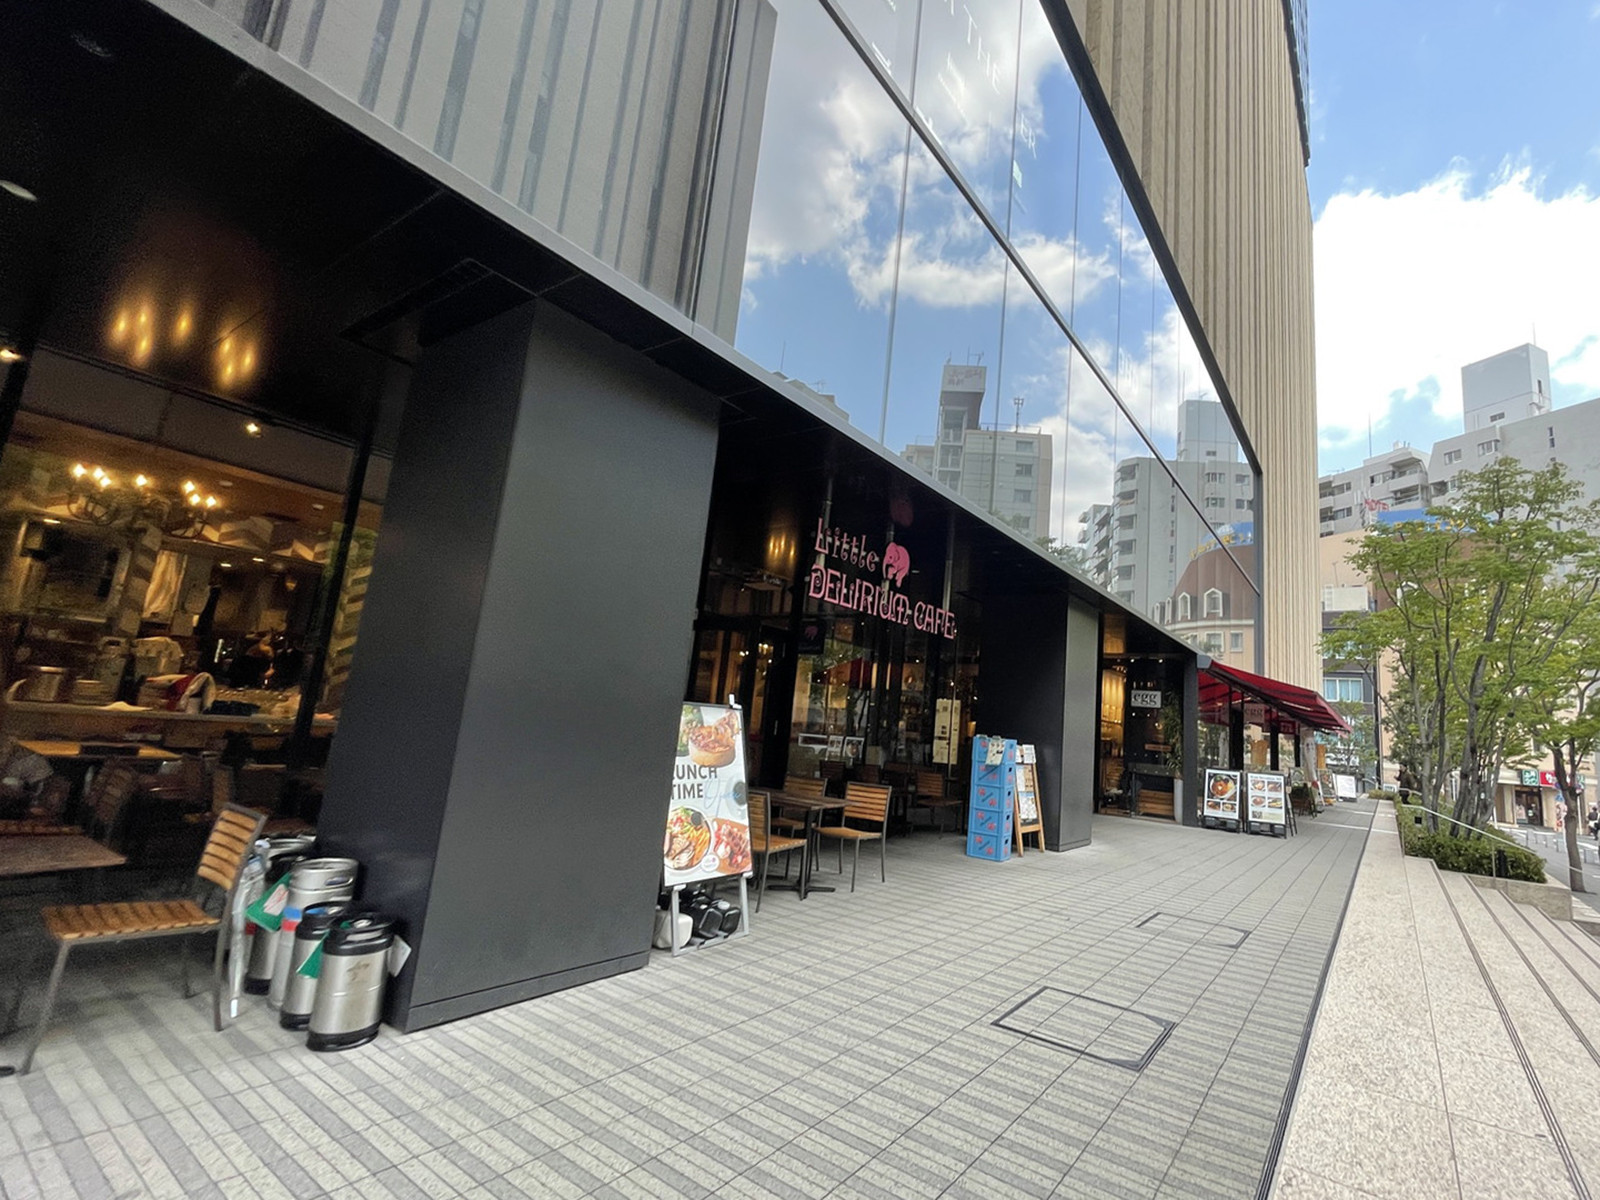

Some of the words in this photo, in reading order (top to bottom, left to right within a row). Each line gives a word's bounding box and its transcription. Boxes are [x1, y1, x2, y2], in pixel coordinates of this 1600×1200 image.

[814, 517, 877, 572] Little
[808, 563, 909, 625] DELIRIUM
[914, 601, 955, 640] CAFE
[1133, 693, 1158, 706] egg
[673, 764, 718, 780] UNCH
